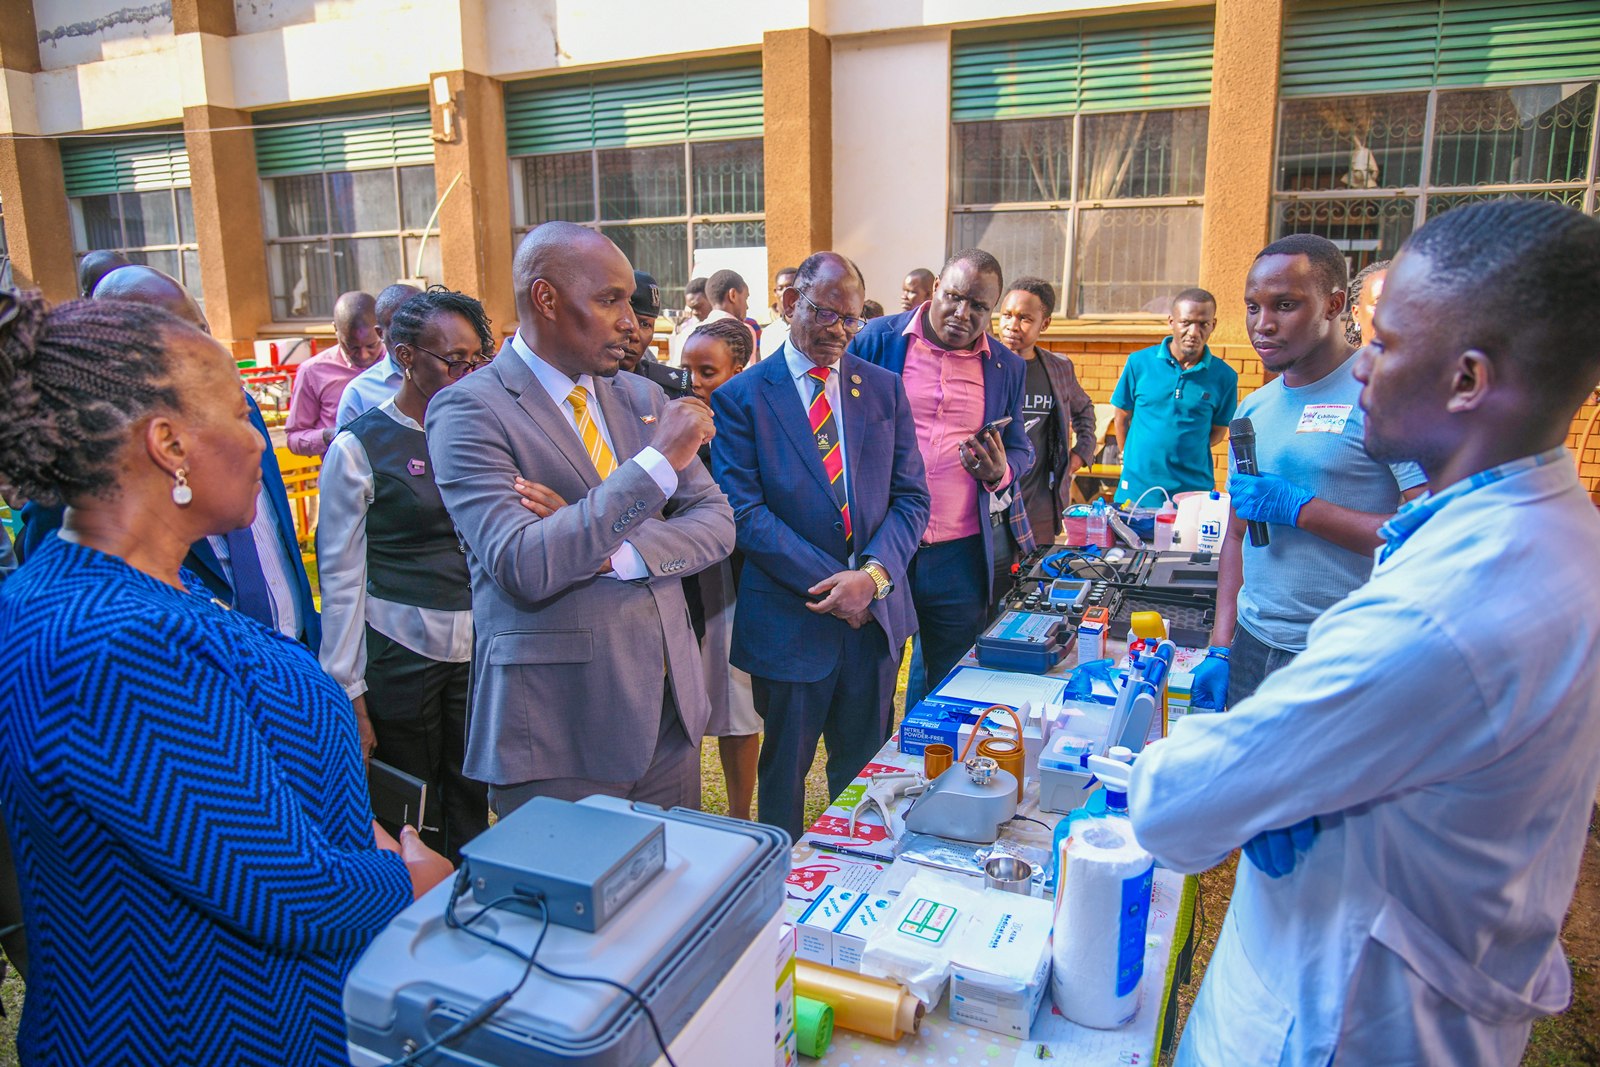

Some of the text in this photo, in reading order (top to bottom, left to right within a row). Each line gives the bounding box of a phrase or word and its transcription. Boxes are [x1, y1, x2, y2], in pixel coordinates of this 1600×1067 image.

[1022, 394, 1056, 409] LPH
[904, 731, 944, 741] POWDER-FREE
[829, 898, 841, 914] Alcohol
[865, 905, 878, 922] Alcohol
[860, 914, 868, 926] Pads
